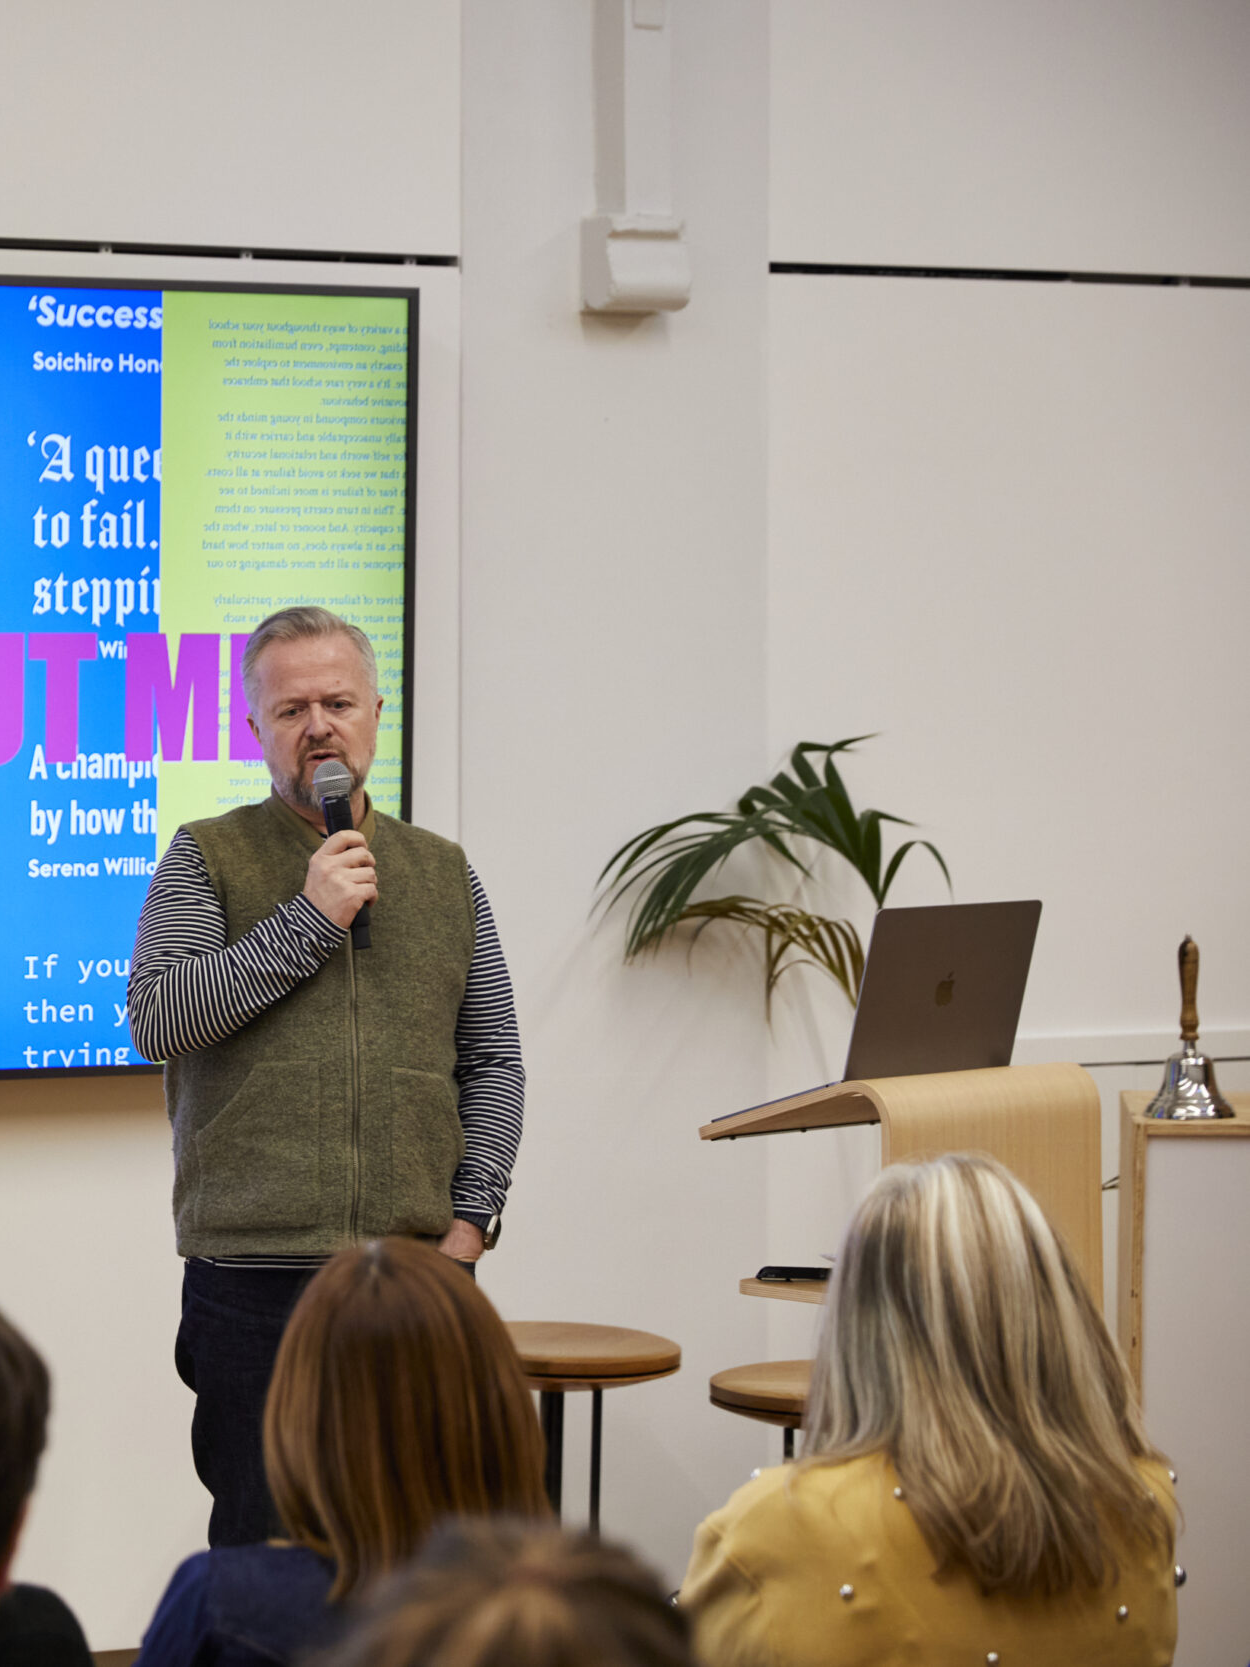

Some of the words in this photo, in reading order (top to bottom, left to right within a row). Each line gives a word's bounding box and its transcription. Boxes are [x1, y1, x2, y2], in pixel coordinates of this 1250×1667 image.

[33, 351, 114, 372] Soichiro
[118, 353, 163, 374] Hon
[32, 505, 70, 549] to
[80, 499, 158, 549] fail.
[99, 640, 127, 659] Wi
[29, 744, 48, 780] A
[30, 800, 63, 845] by
[70, 800, 126, 835] how
[28, 858, 99, 878] Serena
[24, 954, 58, 979] If
[78, 959, 129, 984] you
[23, 999, 94, 1023] then
